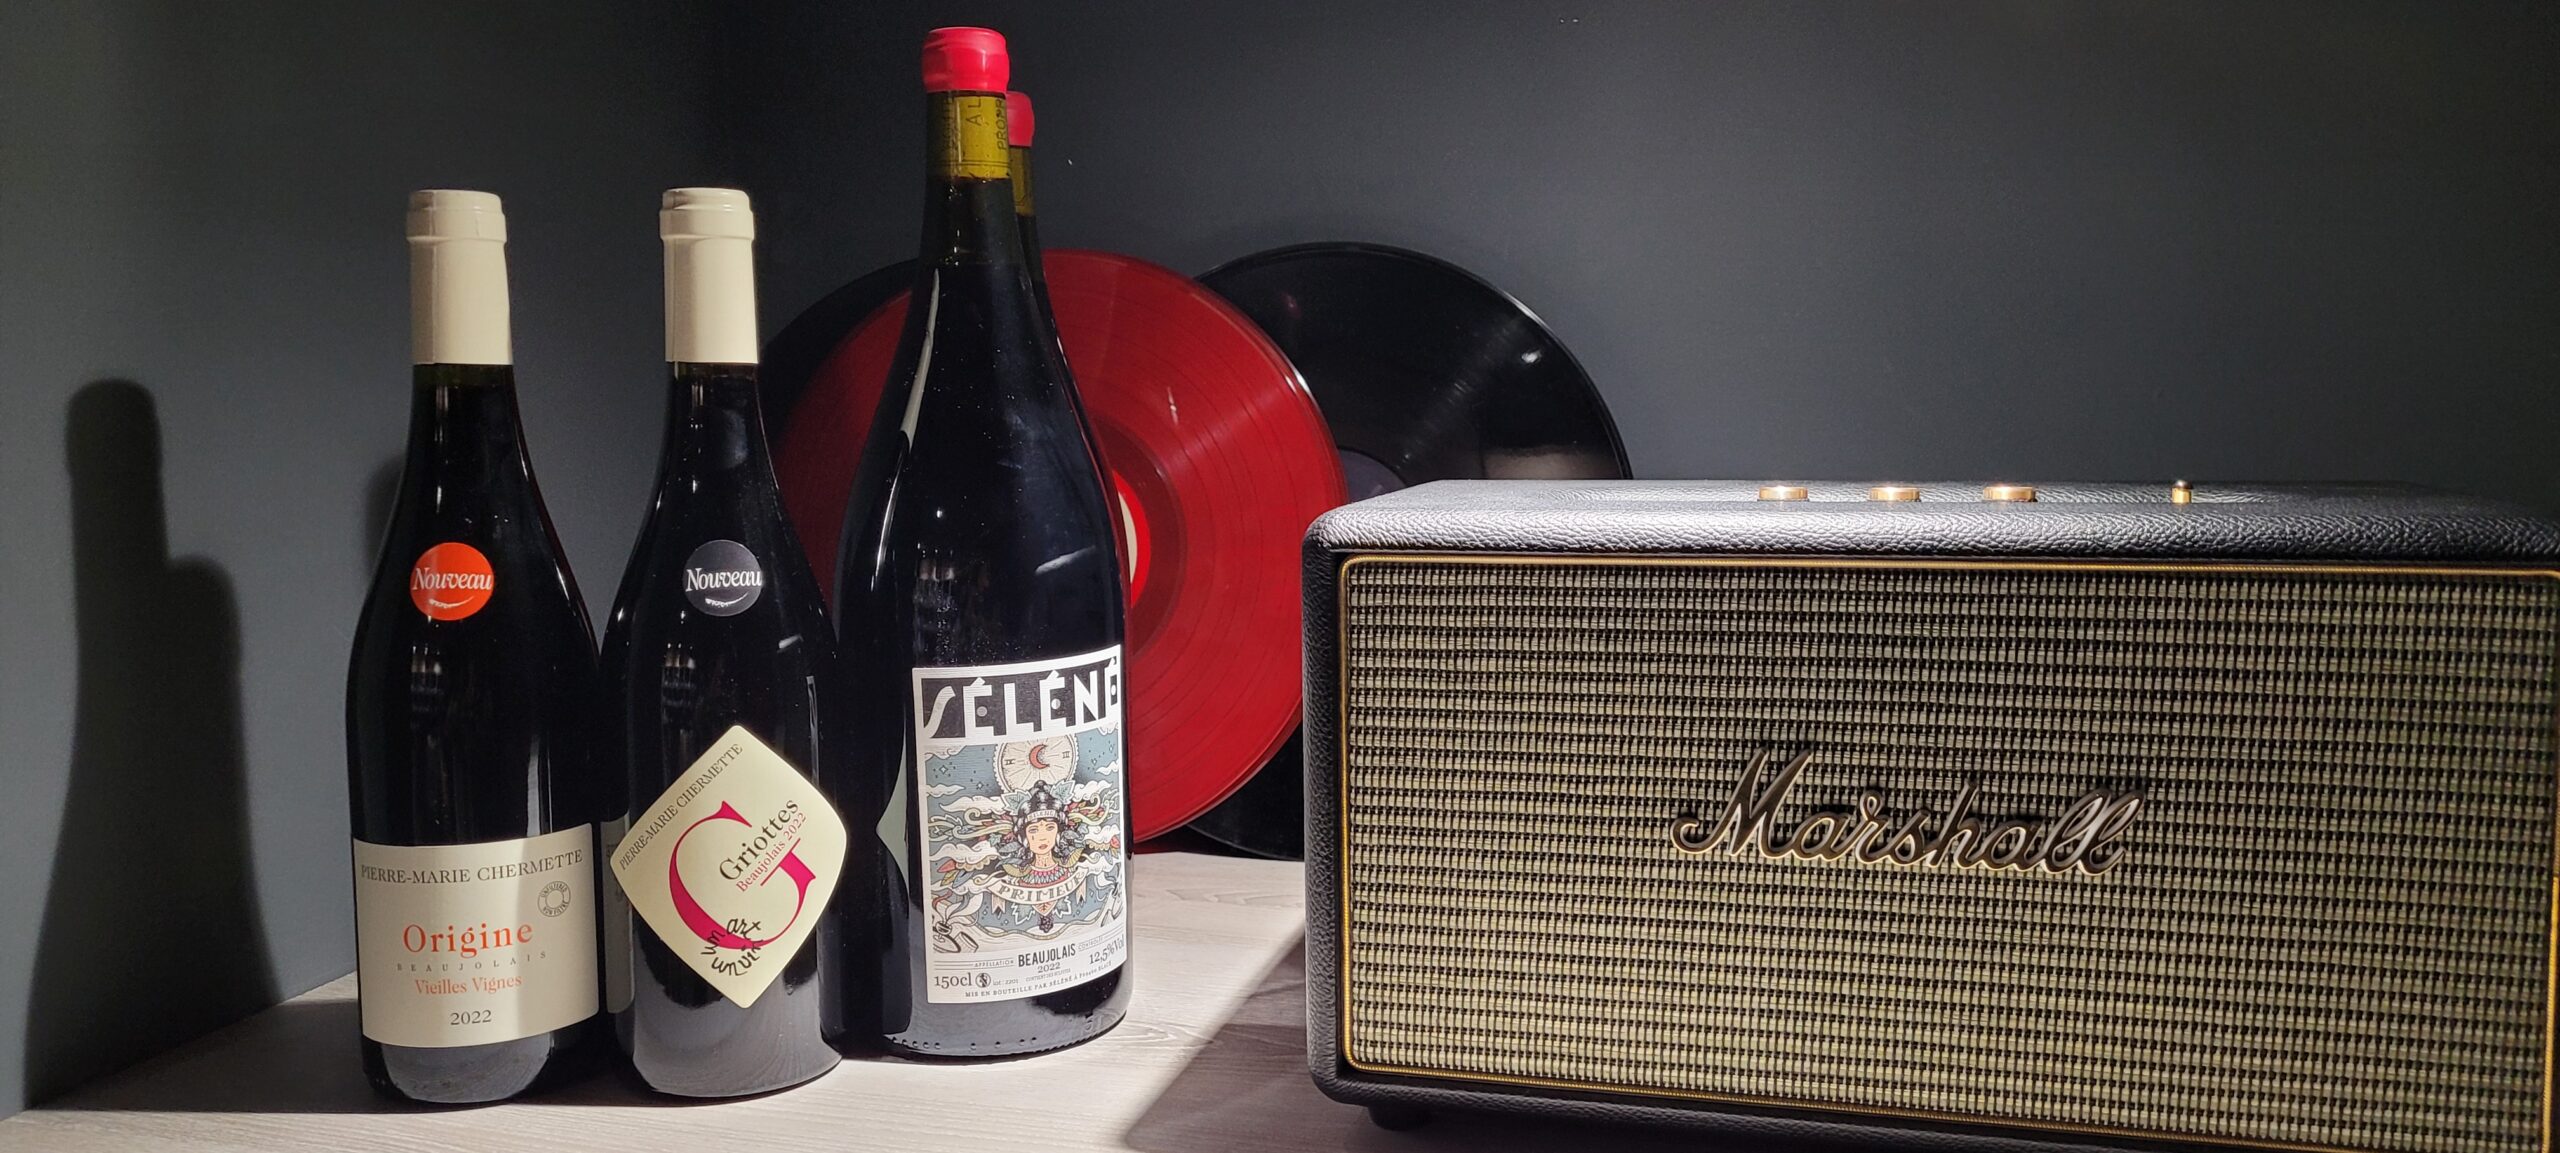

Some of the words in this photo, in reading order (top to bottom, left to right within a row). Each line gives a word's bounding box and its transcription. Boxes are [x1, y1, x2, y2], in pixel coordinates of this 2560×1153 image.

[412, 567, 493, 591] Nouveau
[686, 567, 762, 592] Nouveau
[619, 804, 678, 871] PIERRE-MARIE
[676, 743, 743, 808] CHERMETTE
[1670, 747, 2146, 876] Marshall
[719, 799, 799, 881] Griottes
[736, 839, 786, 892] Beaujolais
[784, 812, 807, 841] 2022
[361, 864, 471, 884] PIERRE-MARIE
[477, 848, 583, 882] CHERMETTE
[669, 800, 817, 950] G
[998, 871, 1085, 901] PRIMEUR
[403, 922, 533, 959] Origine
[397, 951, 547, 972] BEAUJOLAIS
[1018, 943, 1077, 968] BEAUJOLAIS
[1037, 961, 1061, 974] 2022
[415, 978, 468, 995] Vieilles
[472, 975, 523, 995] Vignes
[934, 972, 972, 990] 150cl
[993, 986, 1032, 996] BOUTEILLE
[1034, 982, 1047, 990] PAR
[450, 1009, 493, 1026] 2022
